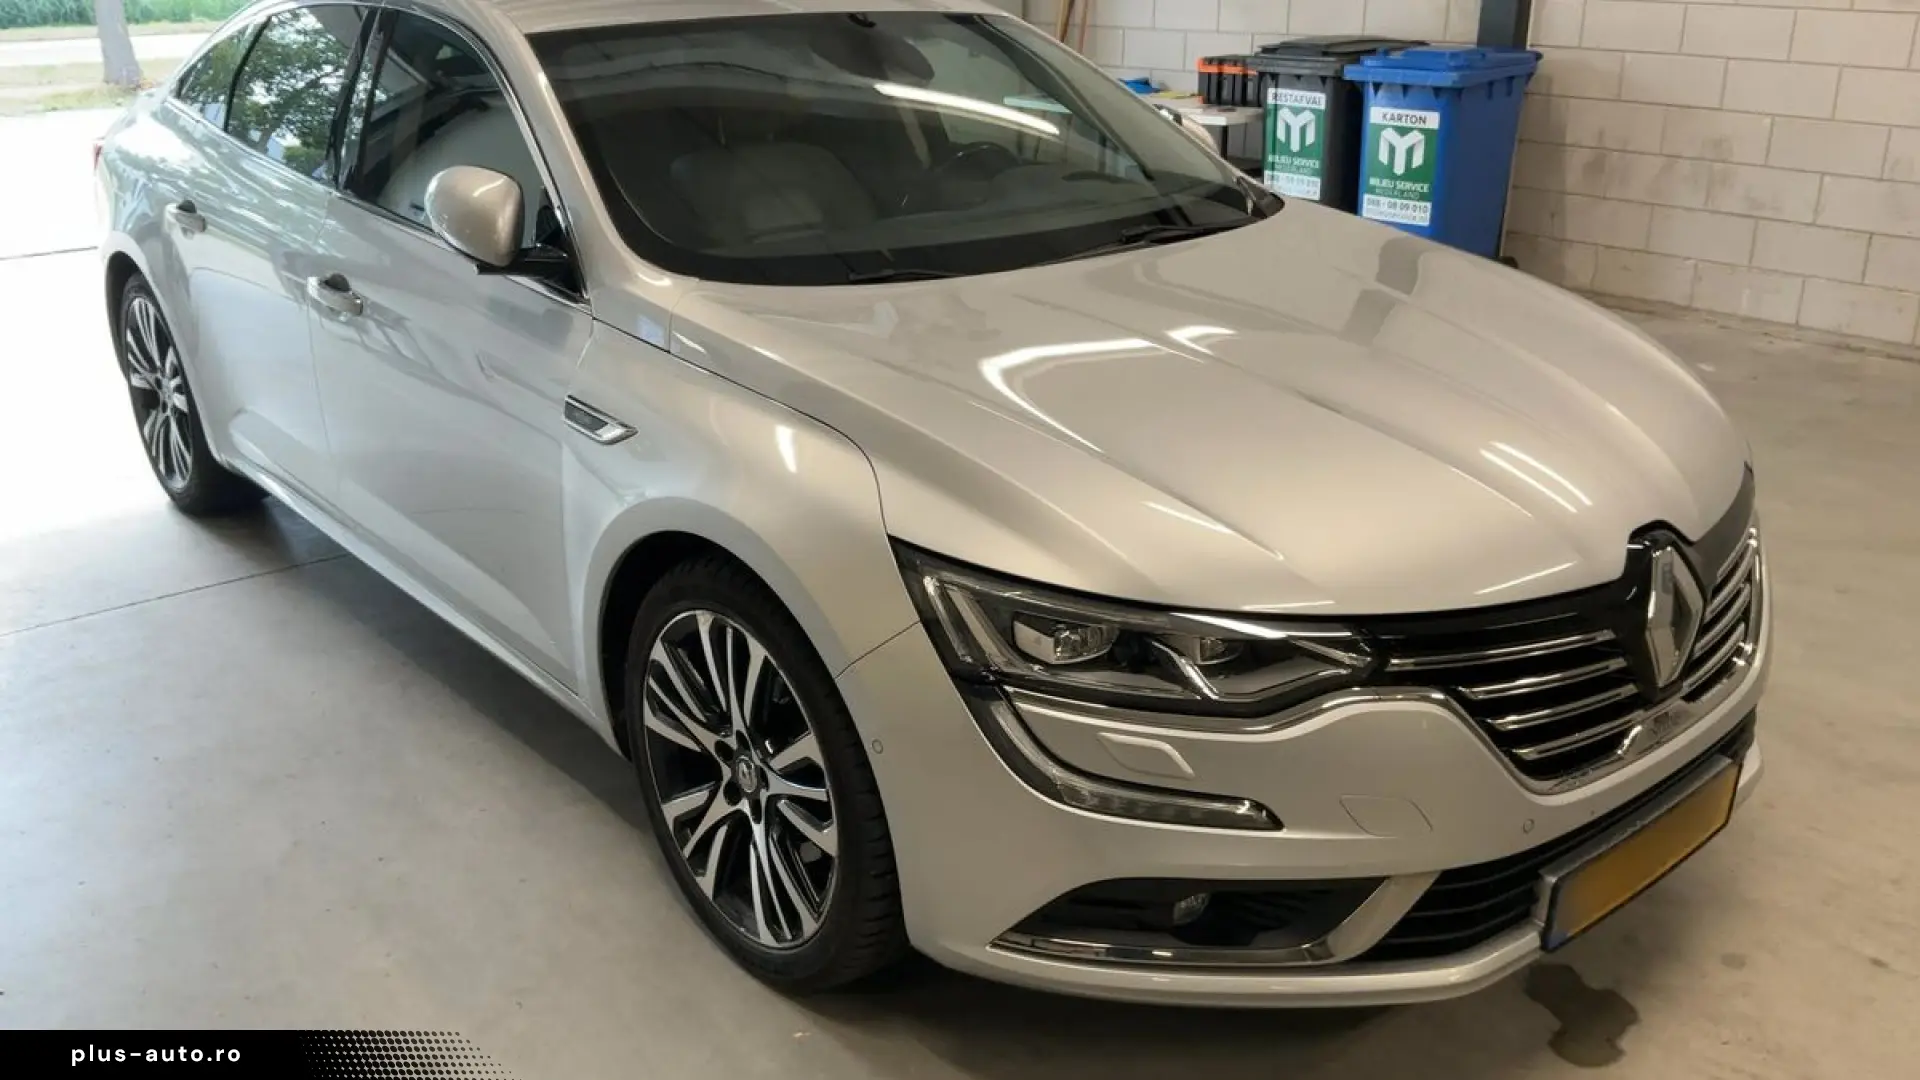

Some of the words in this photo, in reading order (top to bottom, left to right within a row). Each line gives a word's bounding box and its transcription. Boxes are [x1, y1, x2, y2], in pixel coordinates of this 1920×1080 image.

[1381, 111, 1427, 125] KARTON
[1292, 156, 1319, 169] SERVICE
[1395, 180, 1430, 193] SERVICE
[1411, 203, 1428, 214] 010
